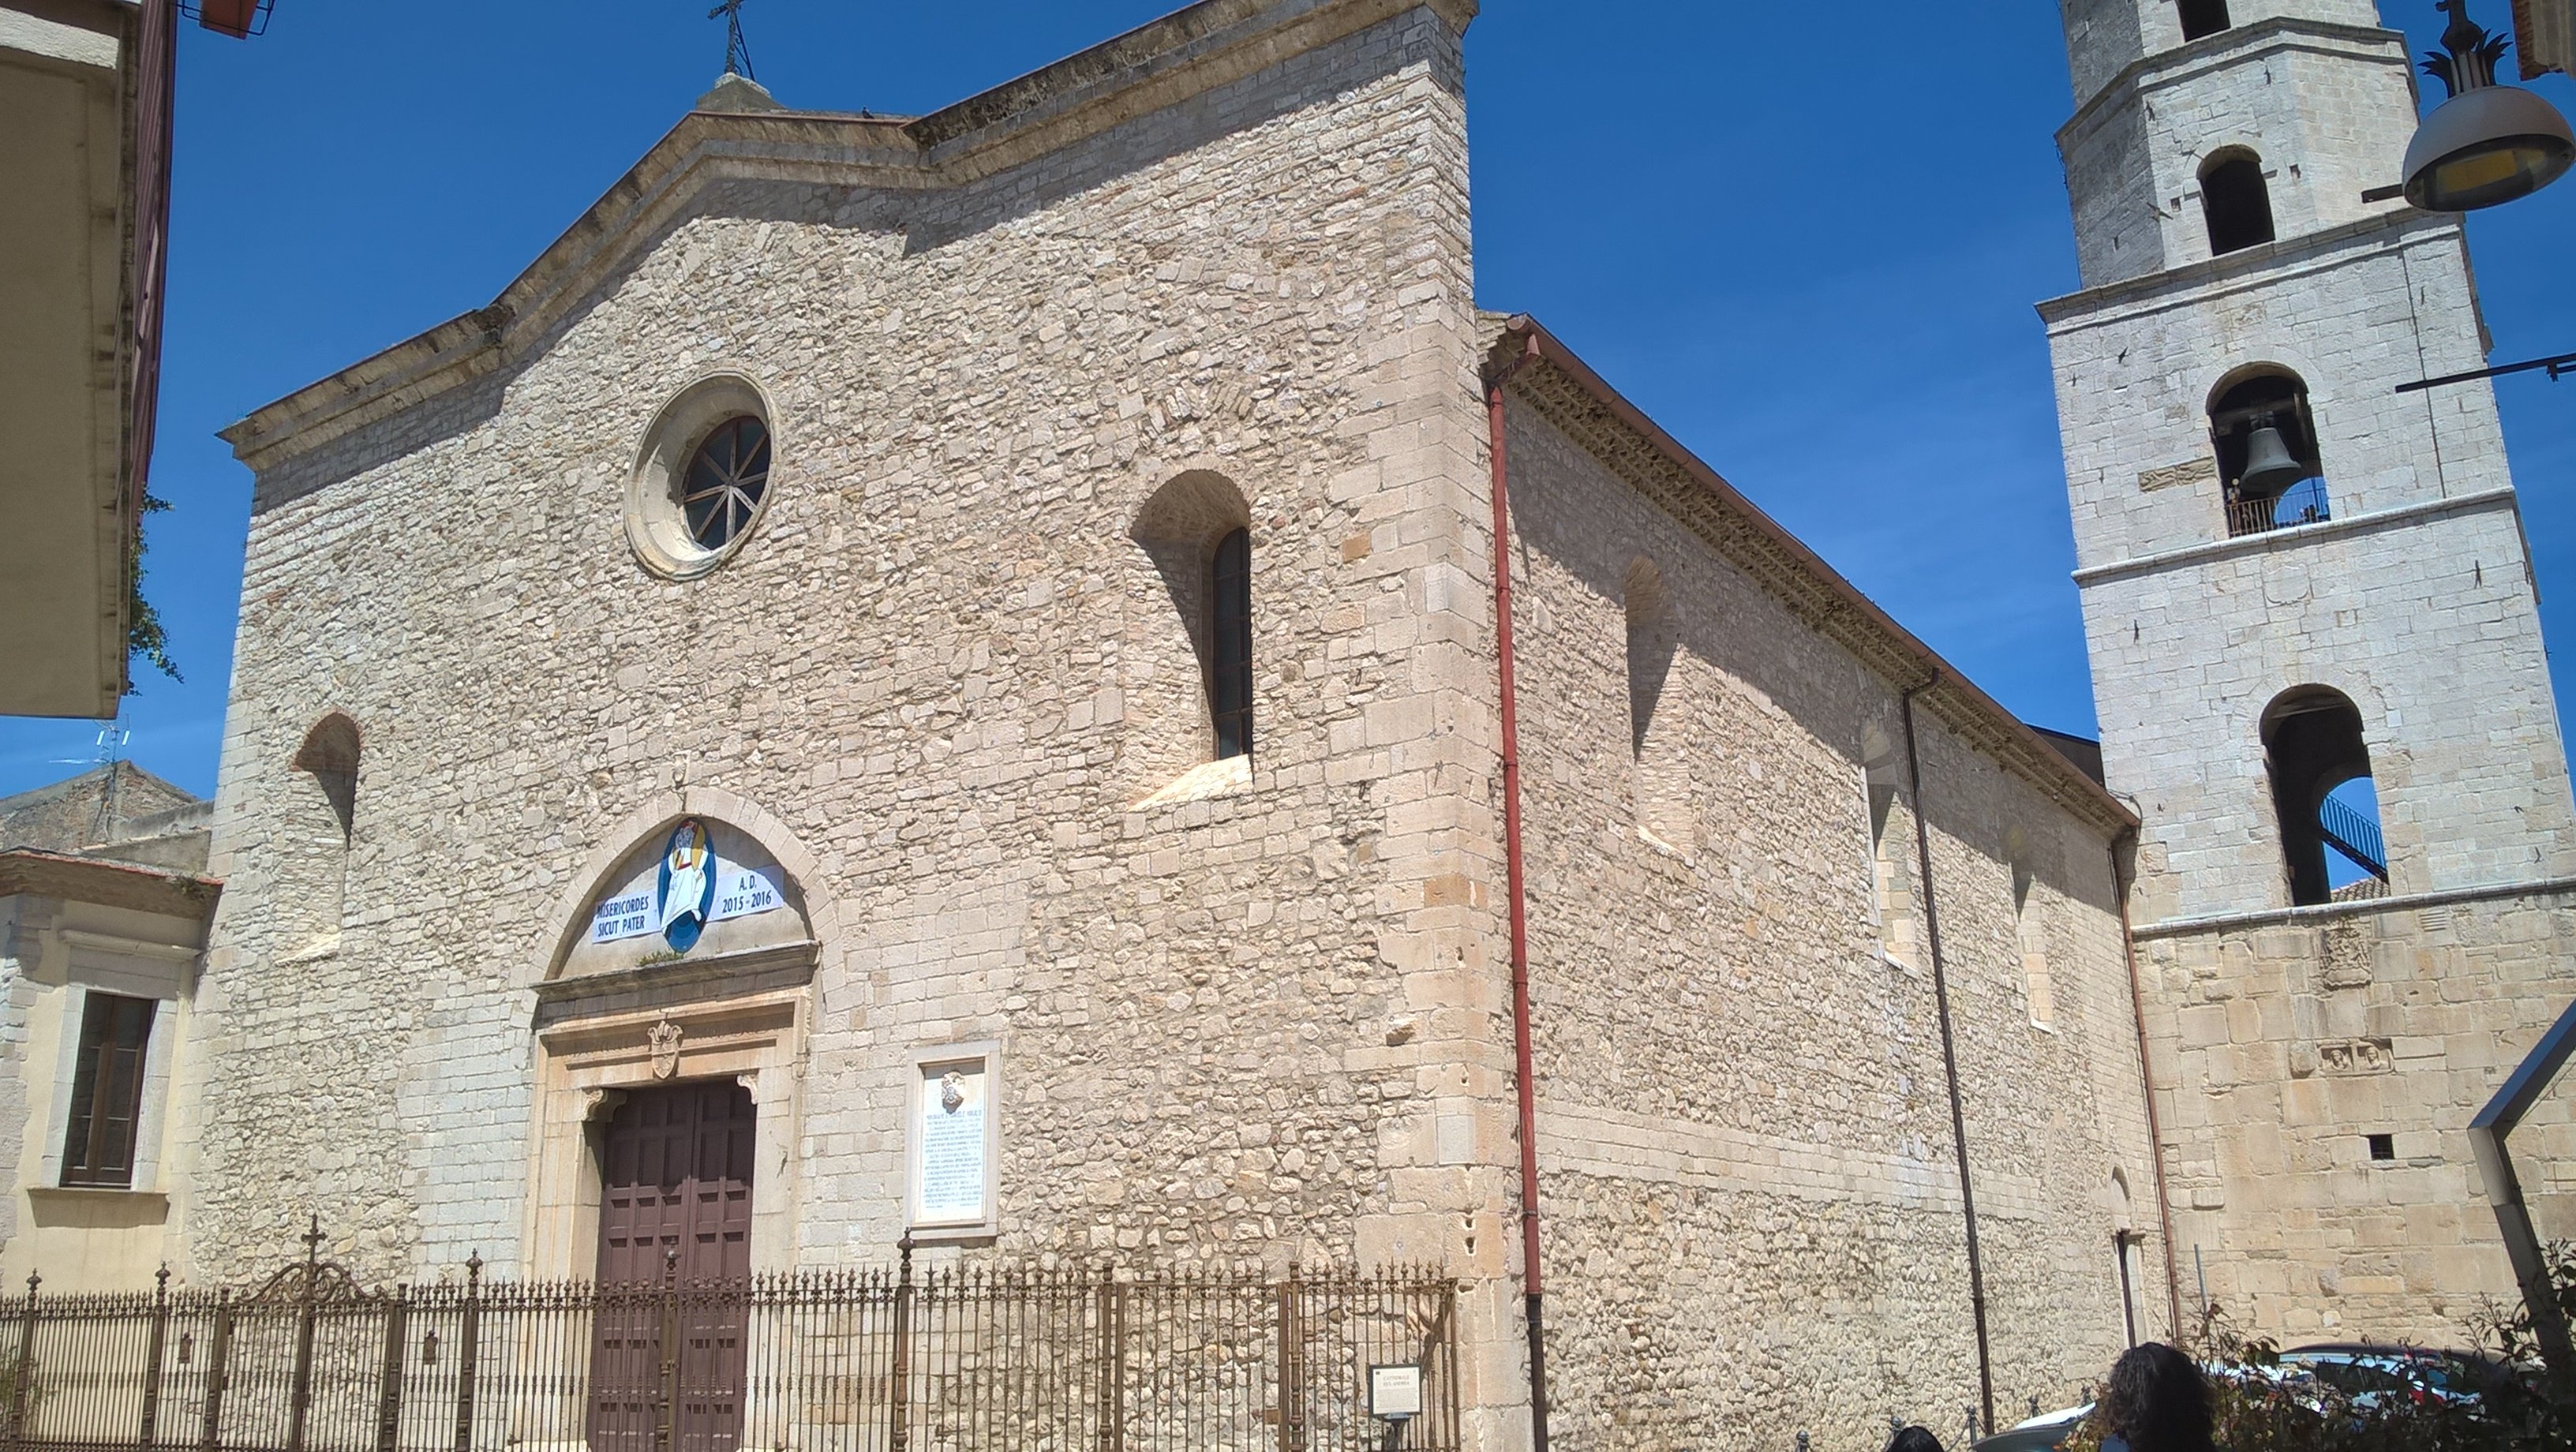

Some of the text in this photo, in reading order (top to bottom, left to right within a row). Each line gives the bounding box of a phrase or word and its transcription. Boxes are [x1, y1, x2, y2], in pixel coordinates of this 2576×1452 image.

[597, 896, 649, 919] MISERICORDES
[598, 915, 645, 937] SICUT PATER
